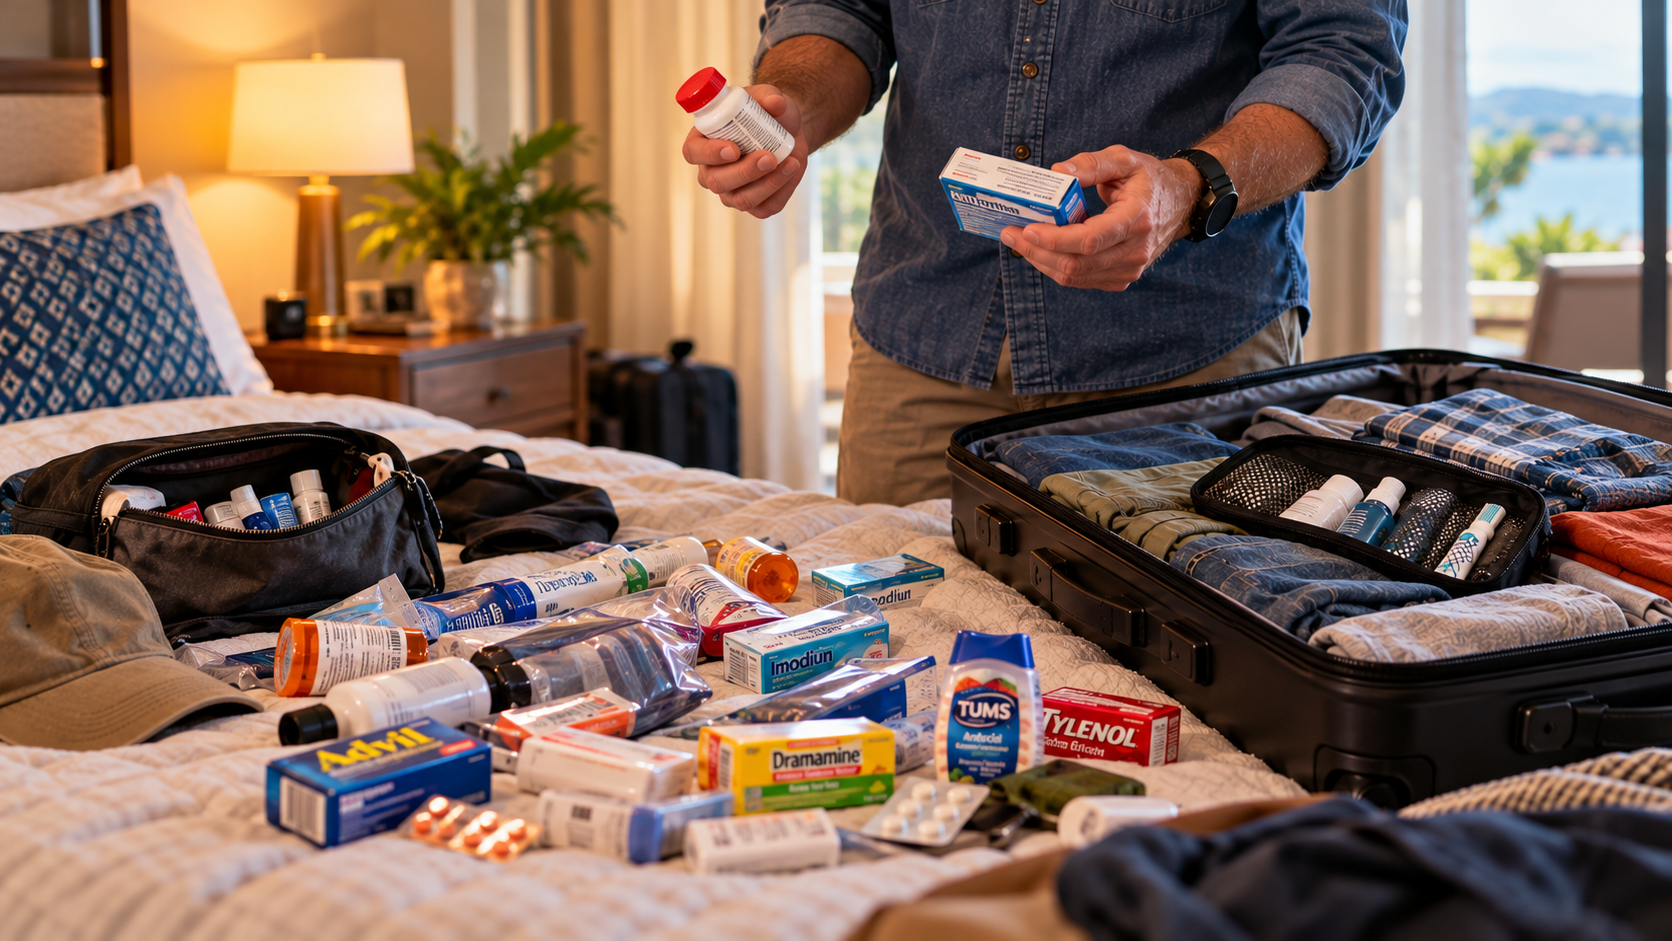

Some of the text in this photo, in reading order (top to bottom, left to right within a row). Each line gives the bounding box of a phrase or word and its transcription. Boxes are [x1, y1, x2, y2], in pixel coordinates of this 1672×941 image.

[957, 700, 1012, 720] TUMS
[1043, 708, 1137, 748] TYLENOL
[316, 726, 433, 773] Advil
[773, 746, 861, 770] Dramamine
